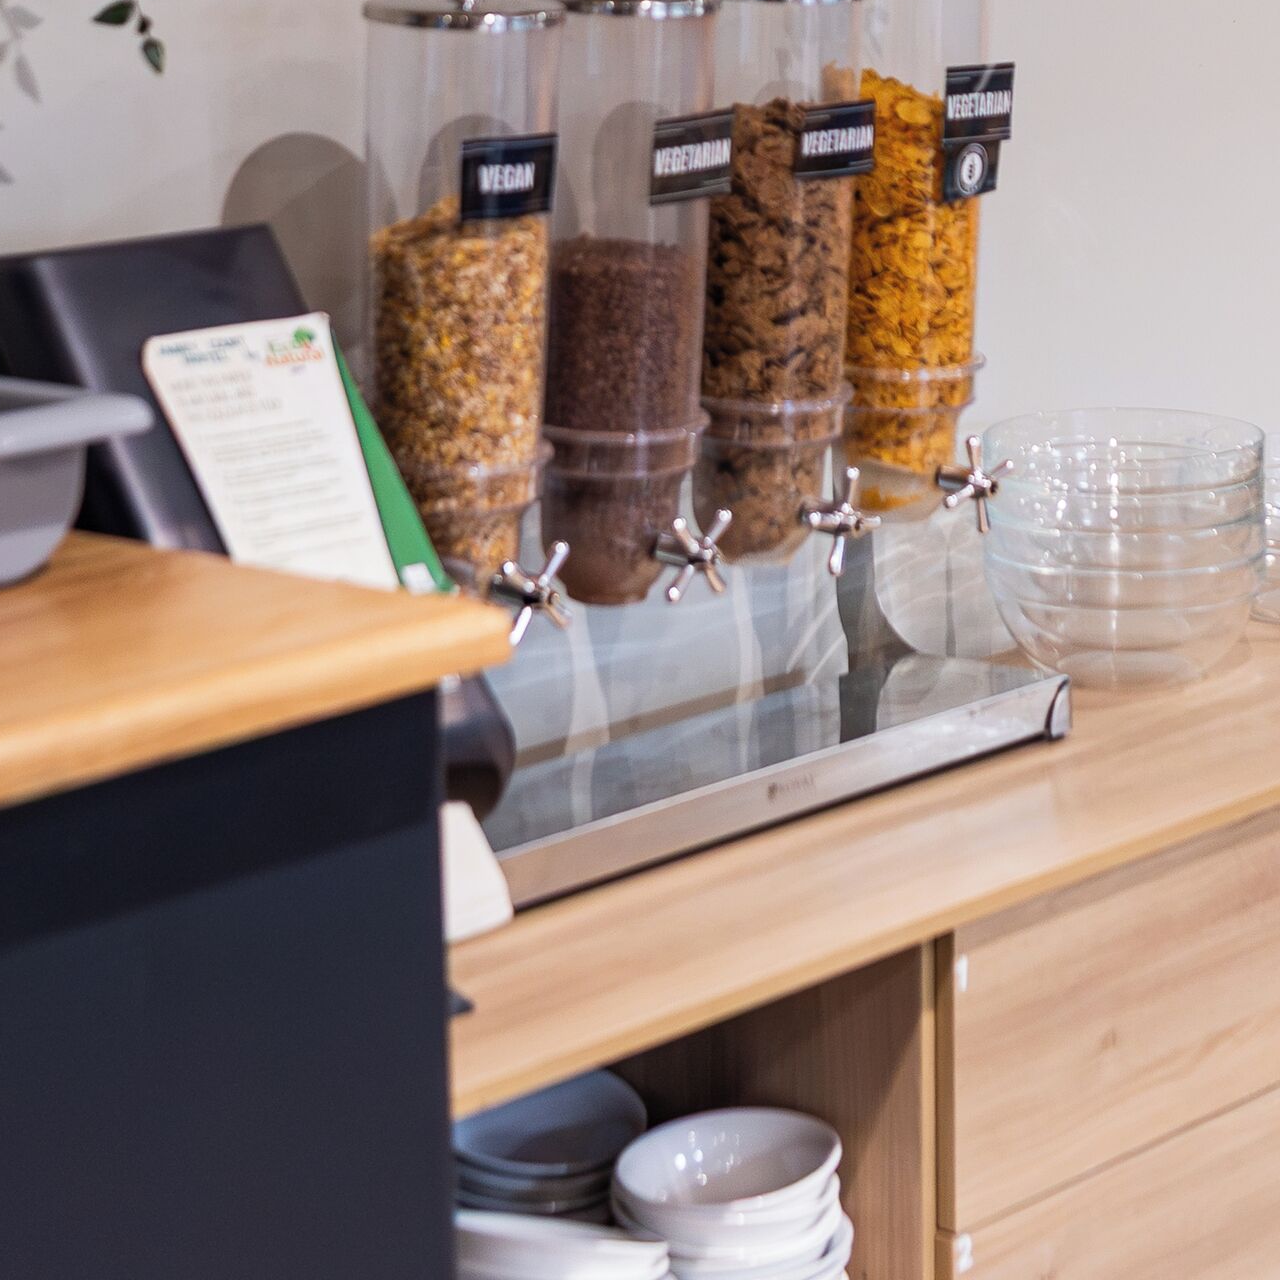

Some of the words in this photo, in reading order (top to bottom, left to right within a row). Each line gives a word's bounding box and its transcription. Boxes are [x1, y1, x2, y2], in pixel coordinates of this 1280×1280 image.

[946, 90, 1012, 120] VEGETARIAN
[654, 138, 732, 177] VEGETARIAN
[802, 125, 874, 157] VEGETARIAN
[478, 161, 535, 195] VEGAN
